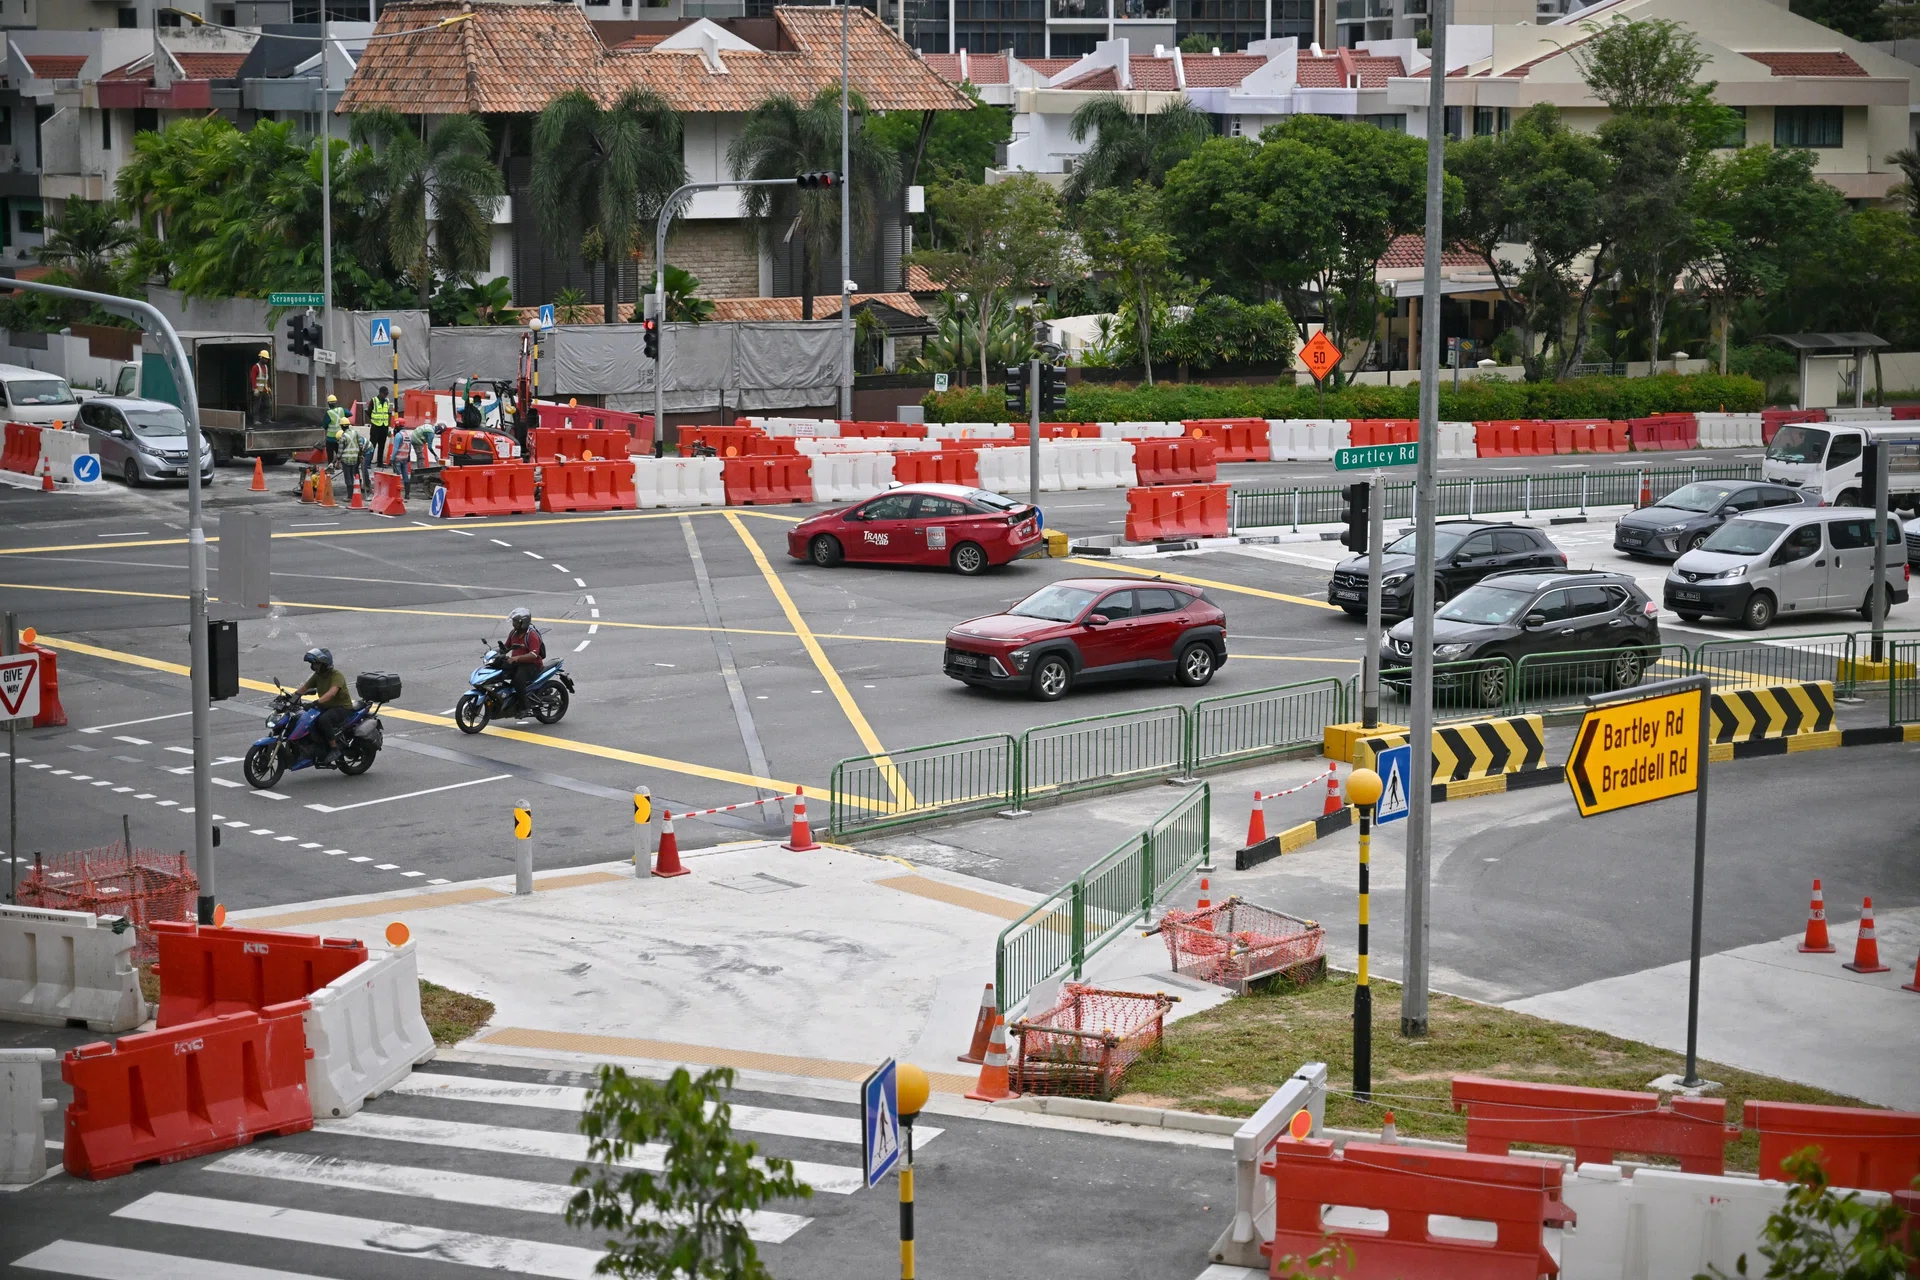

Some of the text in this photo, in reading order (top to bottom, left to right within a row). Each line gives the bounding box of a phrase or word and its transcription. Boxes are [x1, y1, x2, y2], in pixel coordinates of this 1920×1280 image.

[272, 295, 306, 304] Serangoon
[307, 295, 319, 303] Ave
[1313, 352, 1325, 364] 50
[1342, 446, 1415, 465] Bartley Rd
[864, 530, 888, 540] TRANS
[3, 668, 23, 682] GIVE
[6, 684, 19, 694] WAY
[1604, 708, 1684, 751] Bartley Rd
[1602, 747, 1688, 793] Braddell Rd
[243, 942, 269, 954] KTC
